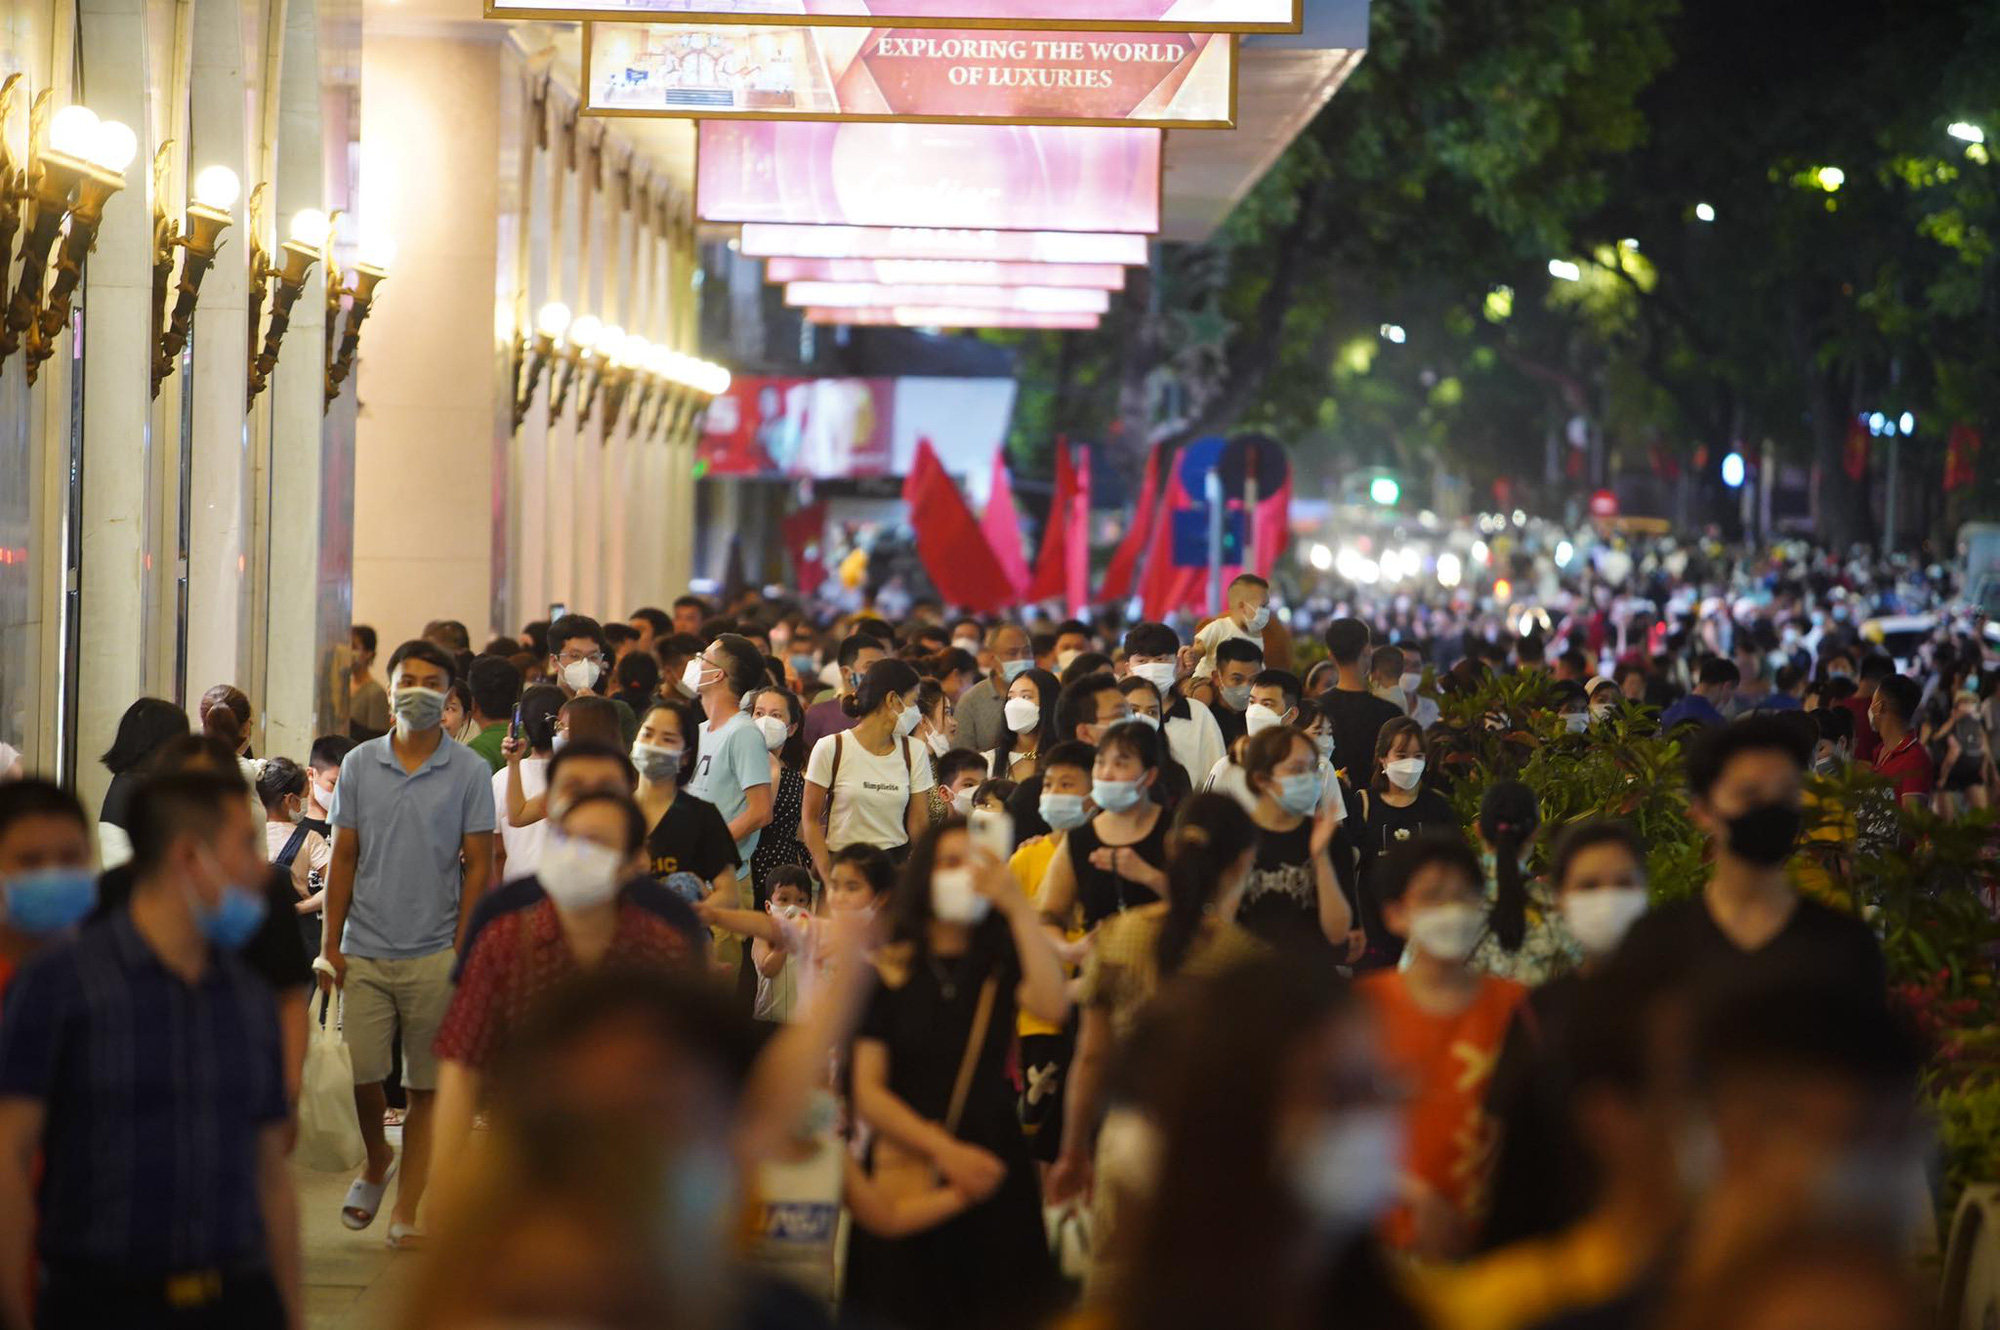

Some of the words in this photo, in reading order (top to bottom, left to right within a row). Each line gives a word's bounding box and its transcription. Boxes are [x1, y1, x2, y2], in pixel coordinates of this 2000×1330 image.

[877, 37, 1027, 61] EXPLORING
[1031, 41, 1084, 61] THE
[1090, 43, 1185, 63] WORLD
[948, 66, 982, 86] OF
[987, 67, 1114, 88] LUXURIES
